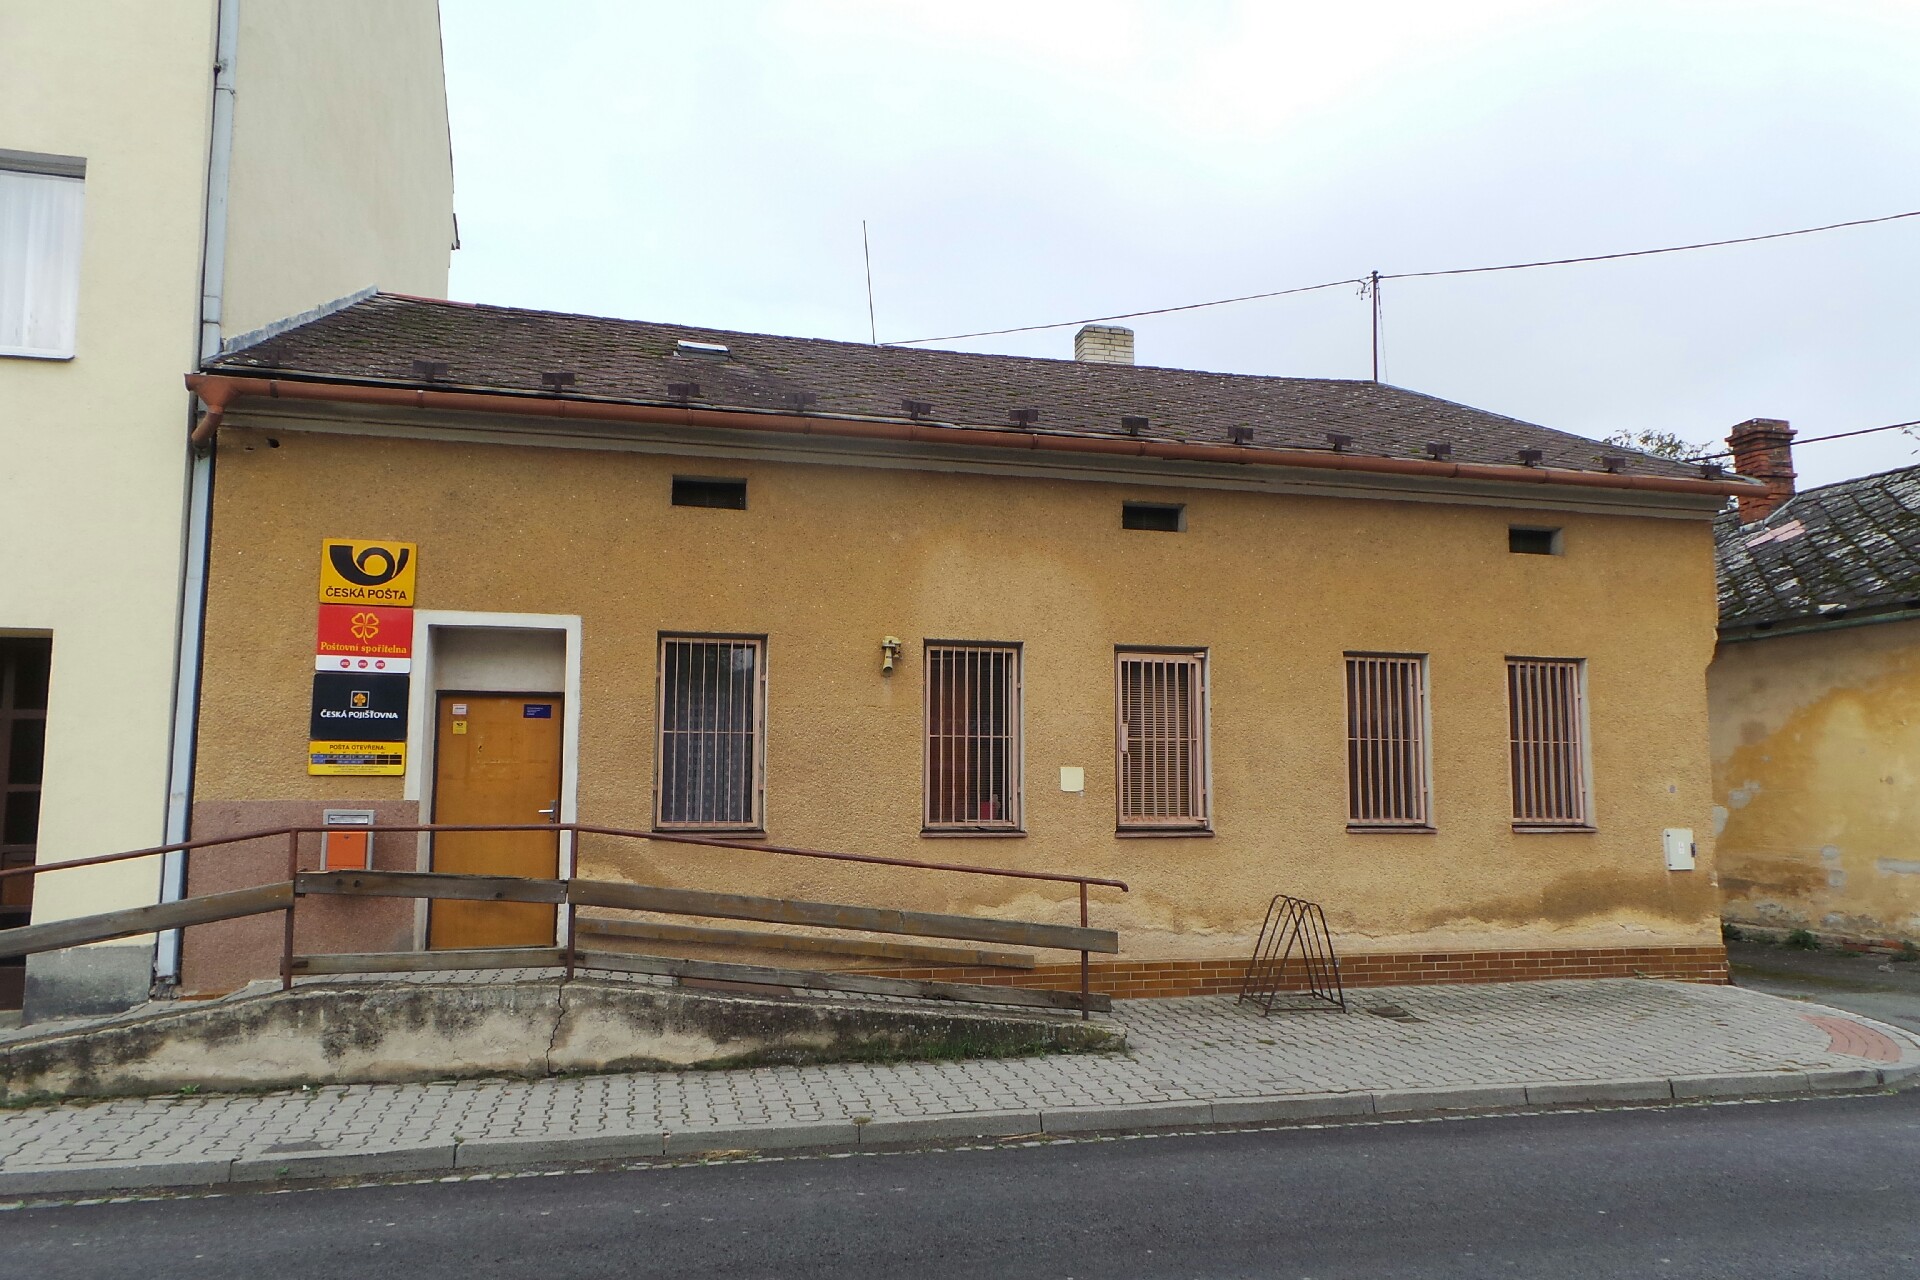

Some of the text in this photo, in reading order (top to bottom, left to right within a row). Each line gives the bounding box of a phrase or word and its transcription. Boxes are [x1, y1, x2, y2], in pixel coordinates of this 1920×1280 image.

[326, 586, 407, 600] ČESKÁ POŠTA
[320, 642, 407, 654] Poštovní spořitelna
[320, 709, 398, 719] ČESKÁ POJIŠŤOVNA
